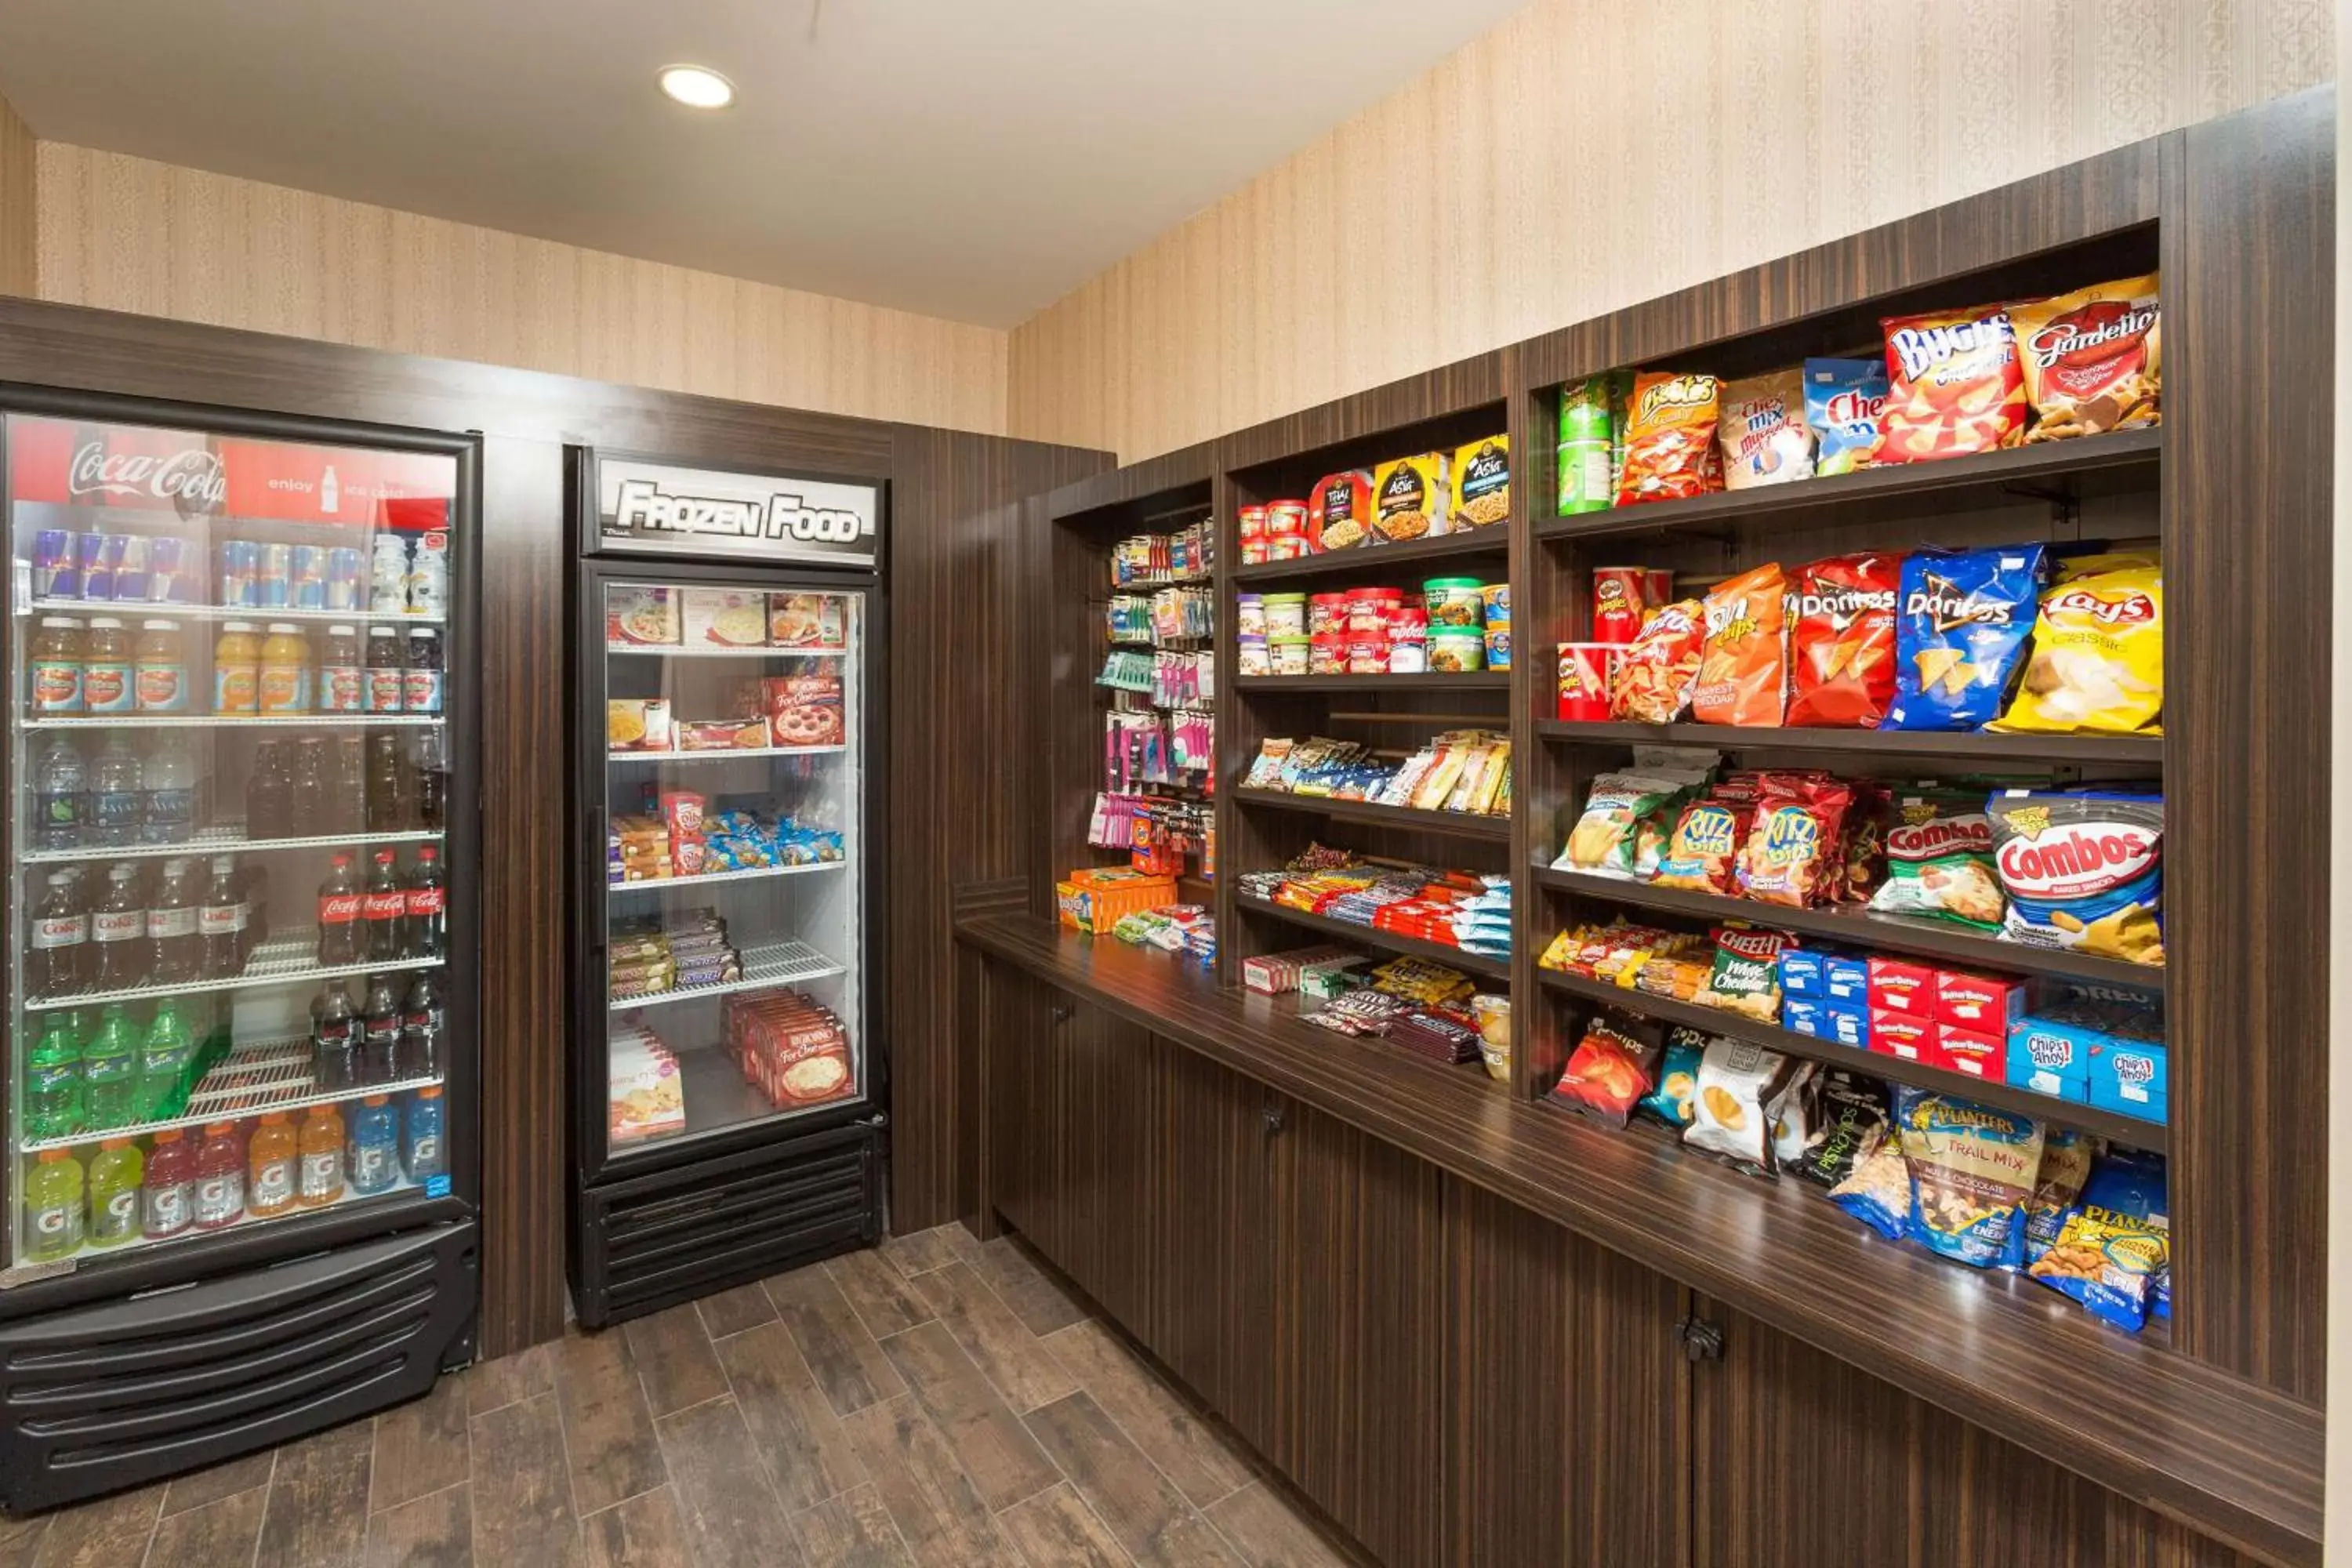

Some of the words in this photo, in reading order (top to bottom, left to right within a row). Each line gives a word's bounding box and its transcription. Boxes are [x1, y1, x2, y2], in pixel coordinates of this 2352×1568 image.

[1742, 391, 1786, 419] Chex
[1826, 388, 1887, 424] Che
[267, 477, 314, 494] enjoy
[616, 479, 763, 538] FROZEN
[766, 493, 862, 544] FOOD
[1803, 591, 1896, 617] Doritos
[1907, 593, 2012, 623] Doritos
[2052, 632, 2129, 654] Classic
[1690, 808, 1733, 841] RITZ
[1768, 812, 1817, 846] RITZ
[1889, 822, 1990, 851] Combo
[2002, 830, 2149, 880] Combos
[42, 920, 81, 936] Coke
[98, 913, 135, 929] Coke
[1726, 960, 1766, 975] White
[1714, 974, 1769, 992] Cheddar
[2029, 1036, 2063, 1052] Chips
[2115, 1058, 2146, 1071] Chips
[1937, 1106, 2015, 1134] PLANTERS
[361, 1149, 382, 1169] G
[416, 1138, 435, 1159] G
[1947, 1138, 1989, 1162] TRAIL
[1994, 1151, 2029, 1171] MIX
[261, 1164, 285, 1186] G
[316, 1154, 336, 1174] G
[201, 1181, 223, 1202] G
[1953, 1174, 2005, 1194] CHOCOLATE
[109, 1191, 134, 1216] G
[154, 1190, 179, 1213] G
[38, 1209, 64, 1233] G
